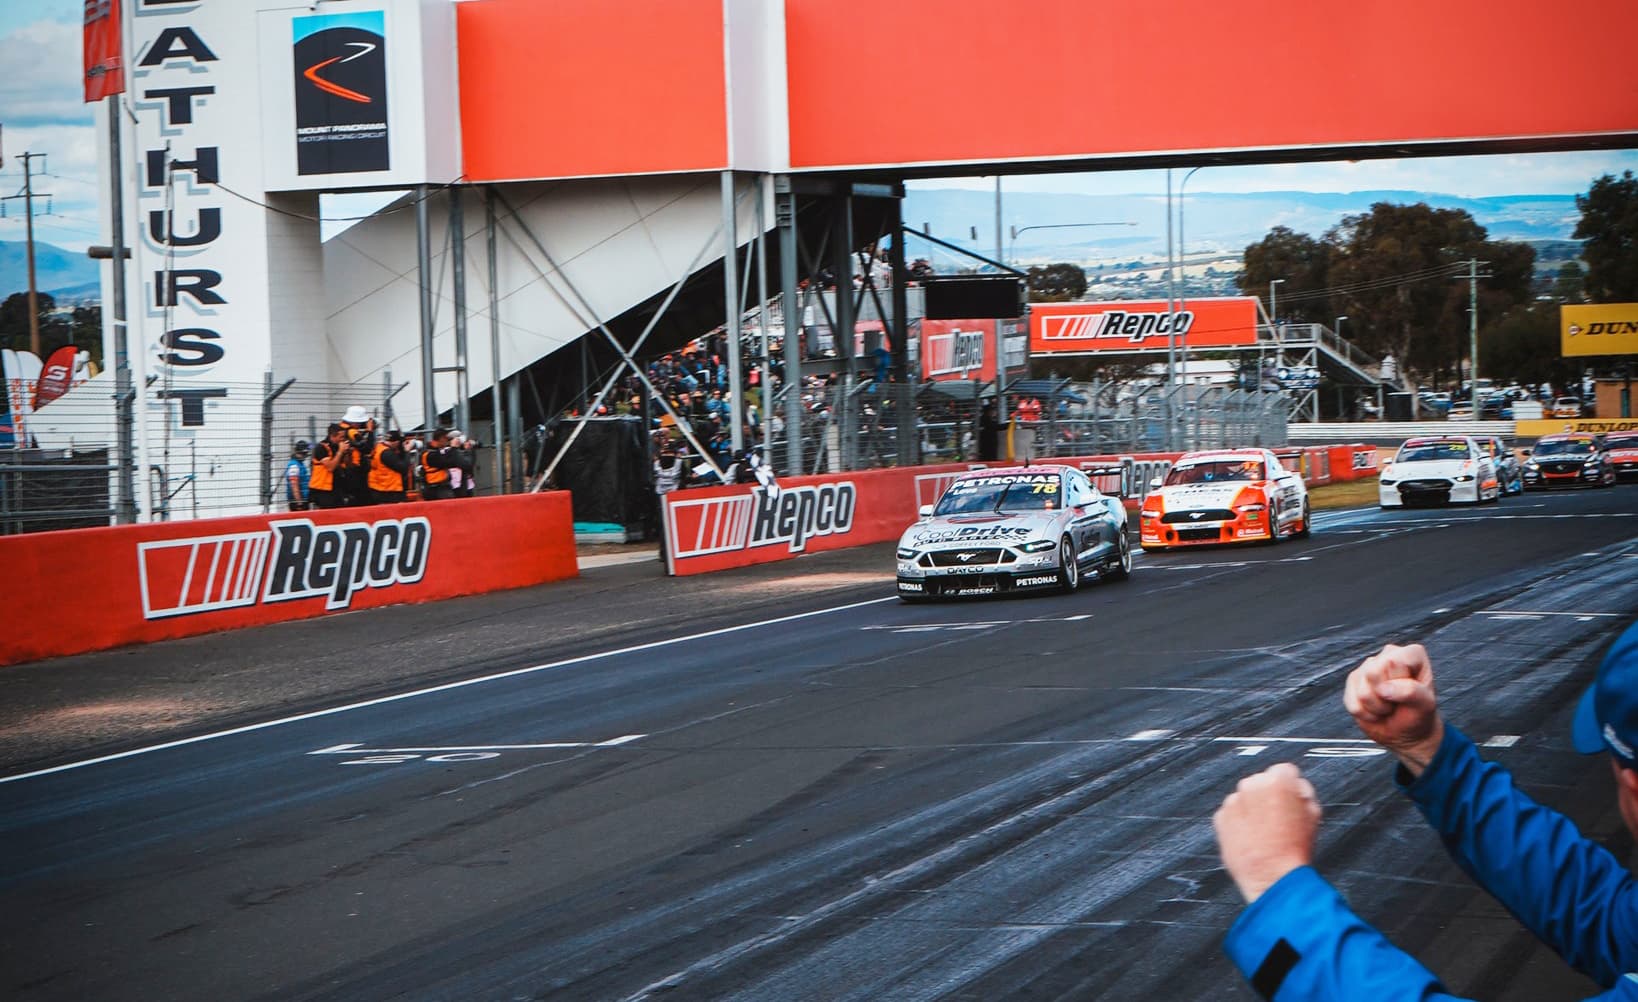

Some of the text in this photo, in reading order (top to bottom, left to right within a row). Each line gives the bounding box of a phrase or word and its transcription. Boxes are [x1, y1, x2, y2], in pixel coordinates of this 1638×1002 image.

[297, 122, 387, 135] MOUNT PANORAMA
[138, 0, 229, 427] ATHURST
[1101, 311, 1194, 342] Repco
[950, 474, 1061, 489] PETRONAS
[1032, 483, 1057, 494] 78
[752, 483, 855, 552] Repco
[263, 518, 432, 610] Repco
[1016, 575, 1058, 587] PETRONAS
[958, 587, 994, 595] BOSCH
